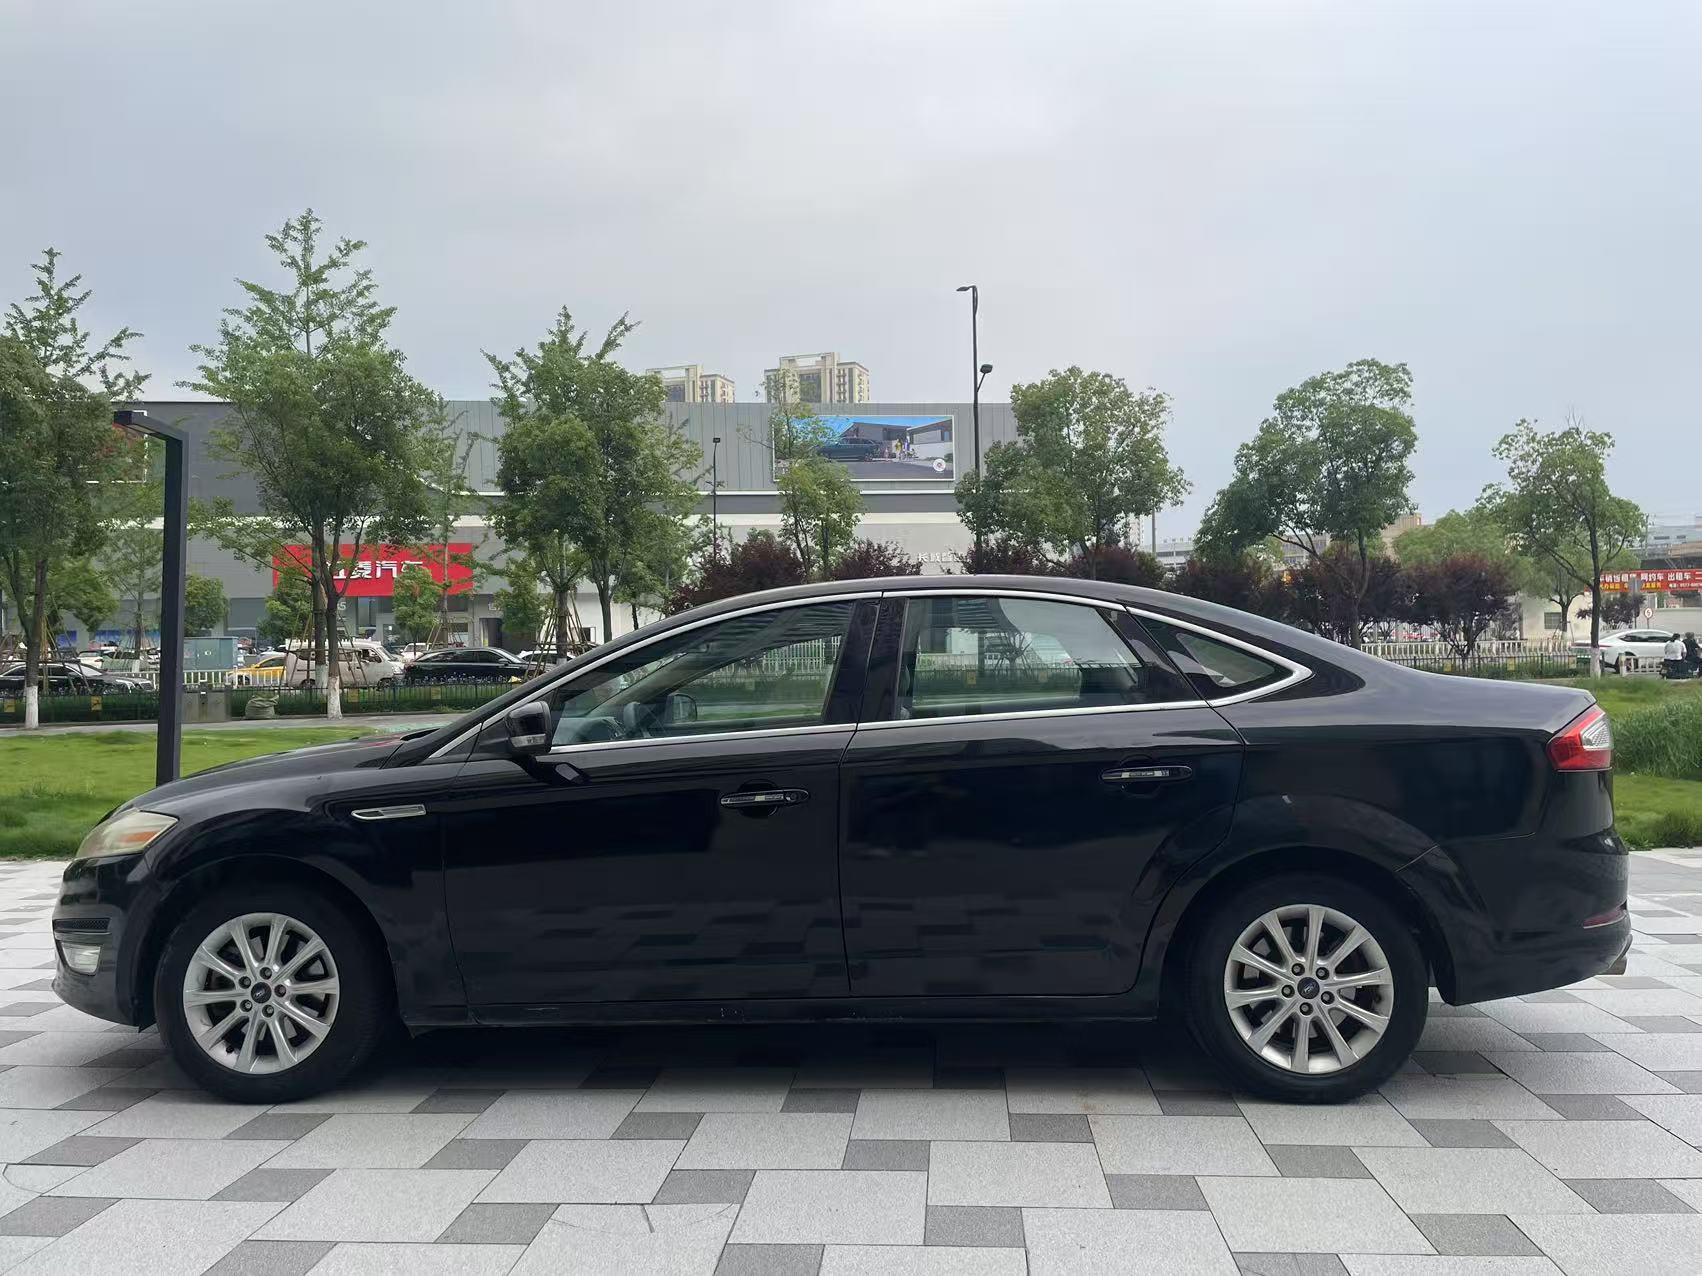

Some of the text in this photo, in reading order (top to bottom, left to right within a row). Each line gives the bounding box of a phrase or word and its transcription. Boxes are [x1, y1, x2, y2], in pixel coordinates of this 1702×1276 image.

[1641, 573, 1664, 582] 网约车
[1668, 572, 1691, 581] 出租车
